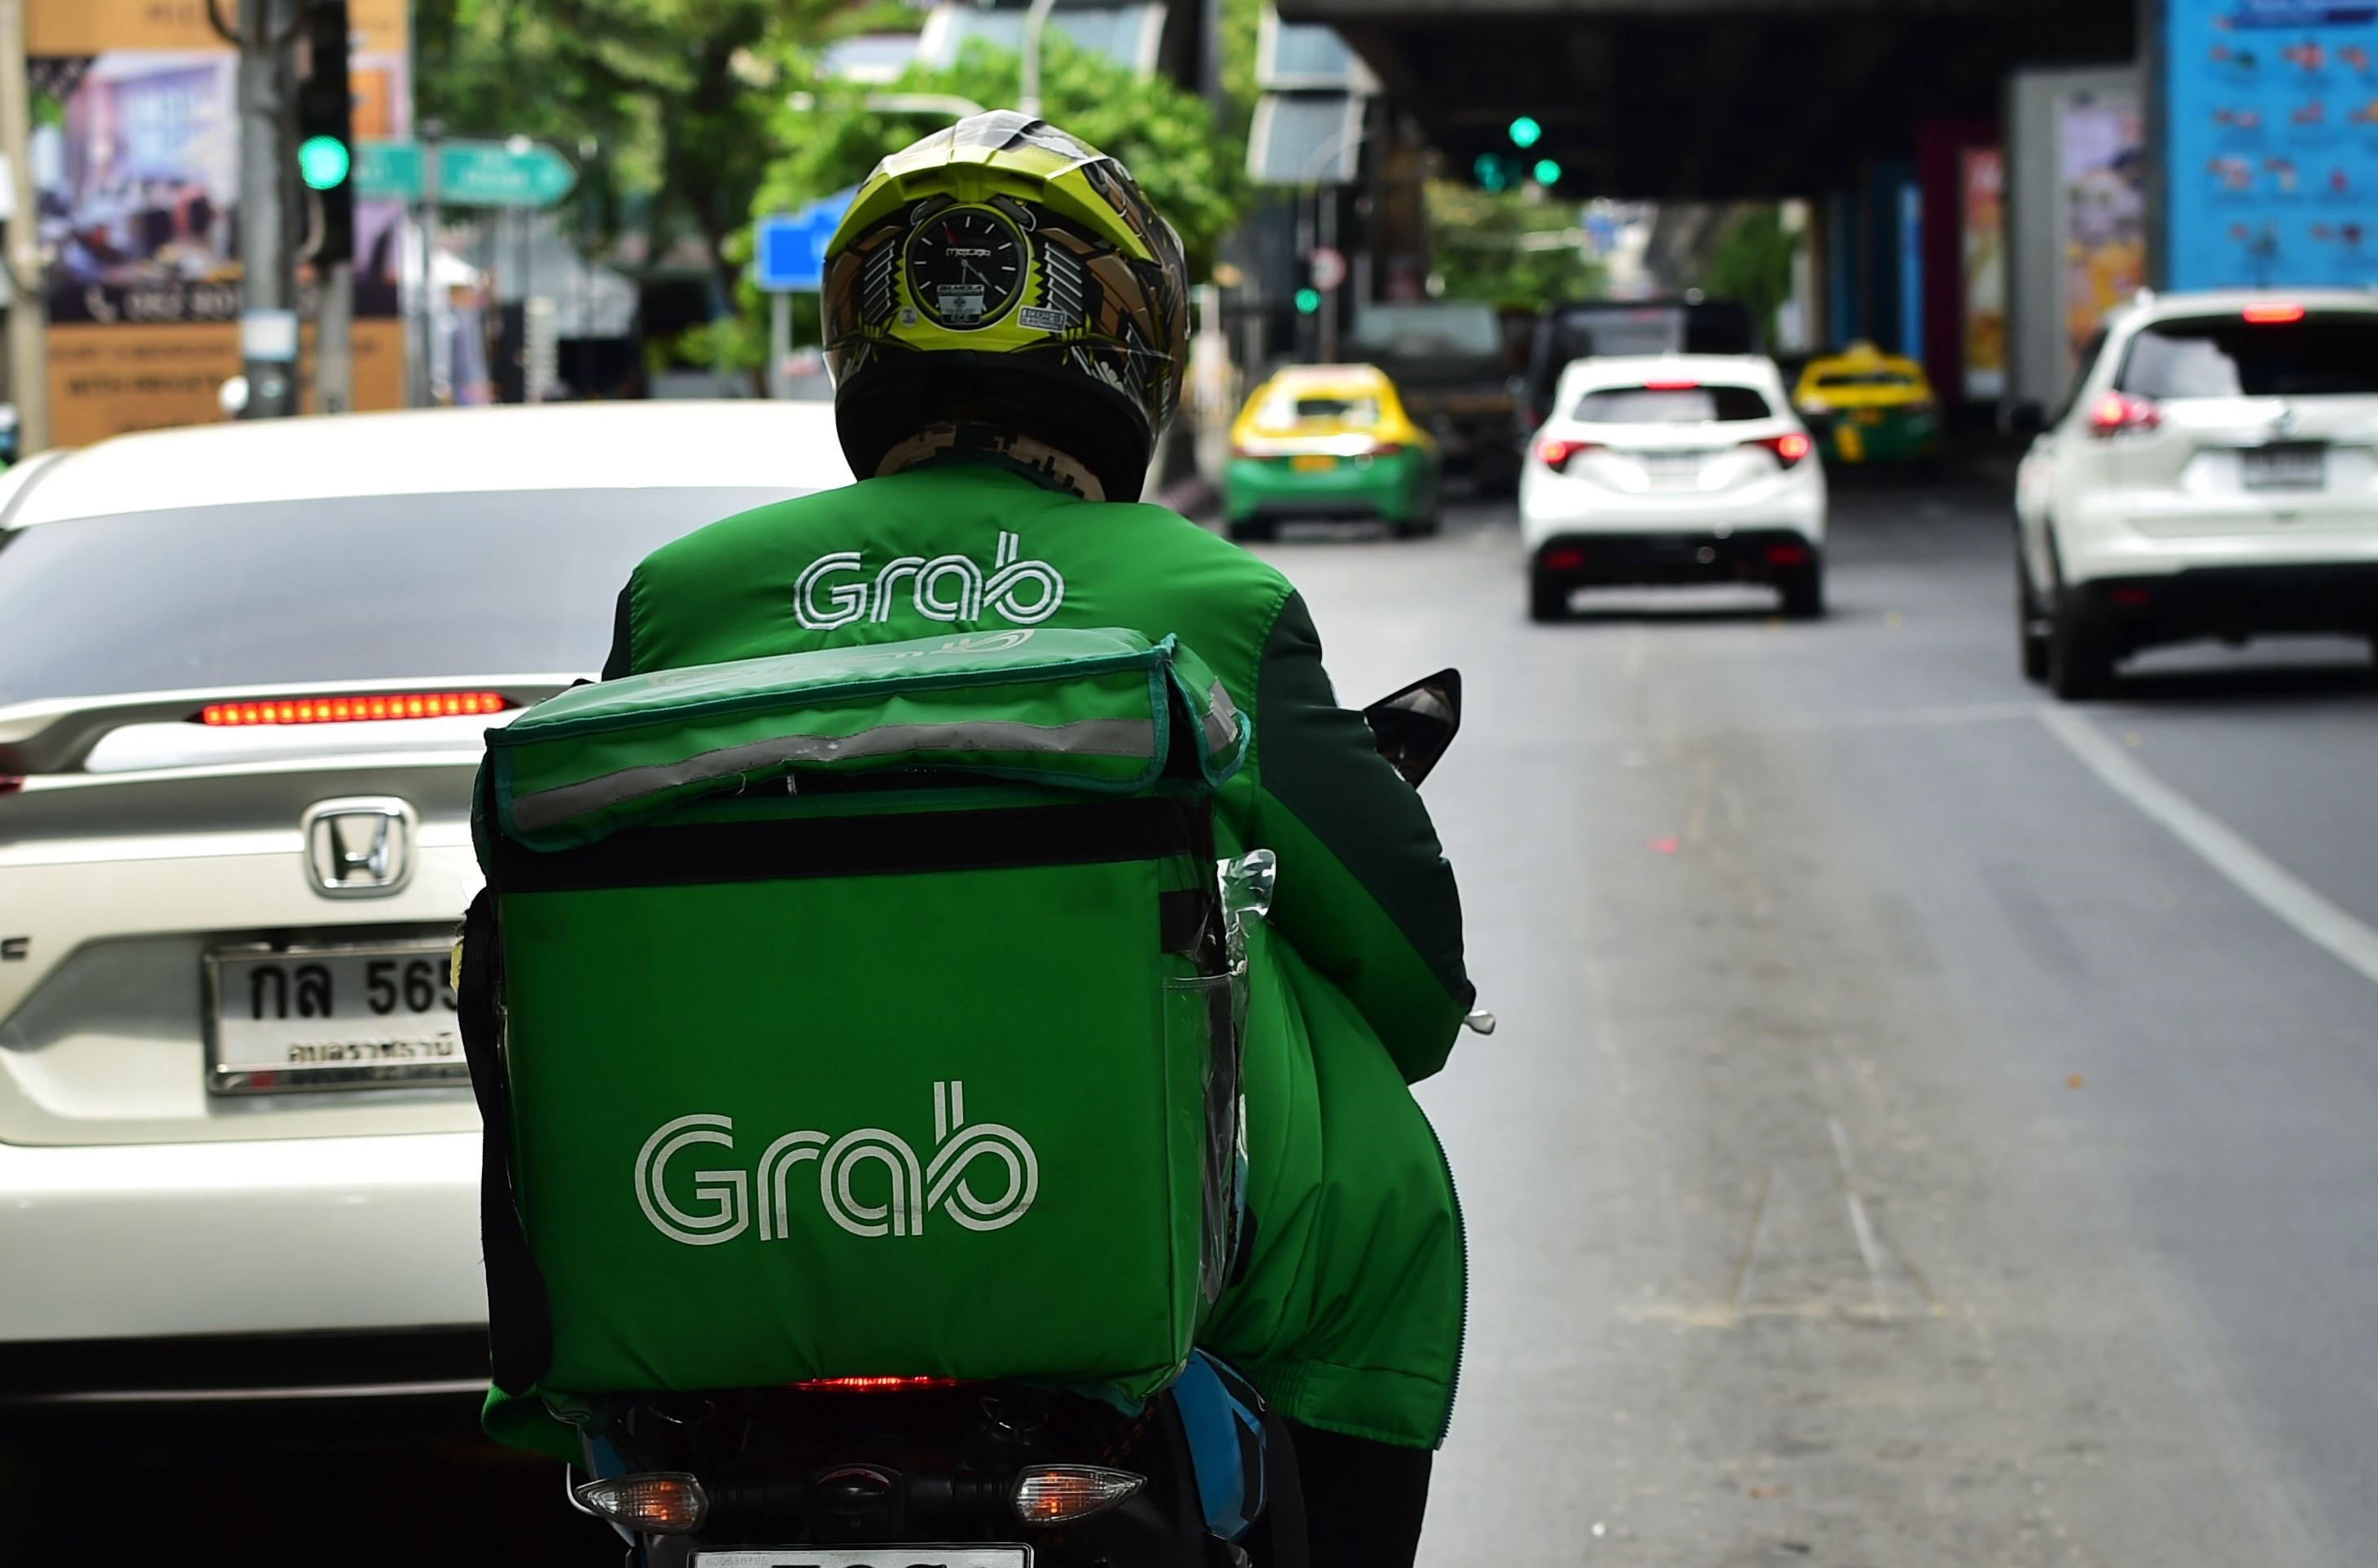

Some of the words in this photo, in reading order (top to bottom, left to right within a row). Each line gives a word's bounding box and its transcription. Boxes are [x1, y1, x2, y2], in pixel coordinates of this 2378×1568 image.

[792, 530, 1065, 631] Grab
[250, 963, 333, 1019] กล
[634, 1080, 1039, 1246] Grab
